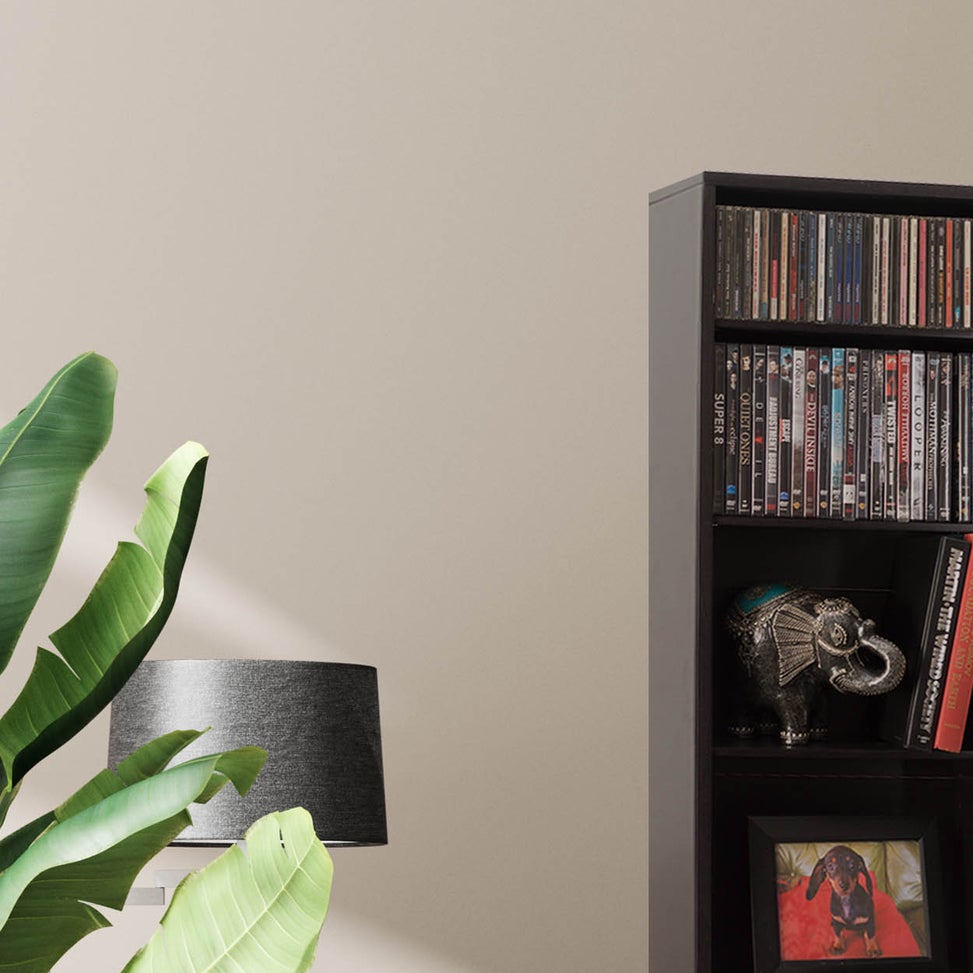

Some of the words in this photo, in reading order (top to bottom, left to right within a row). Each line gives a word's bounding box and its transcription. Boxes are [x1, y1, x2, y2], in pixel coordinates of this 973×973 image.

[861, 360, 870, 414] PRISONERS
[899, 373, 910, 411] HORROR
[714, 393, 725, 434] SUPER
[740, 392, 751, 431] QUIET
[887, 400, 897, 444] TWISTED
[928, 401, 937, 454] MOTHMAN
[714, 436, 725, 445] 8
[740, 431, 751, 466] ONES
[914, 395, 923, 471] LOOPER
[942, 548, 963, 603] MARTIN
[937, 606, 954, 633] THE
[929, 633, 949, 680] WIRED
[954, 645, 967, 669] AND
[947, 673, 961, 710] EARTH
